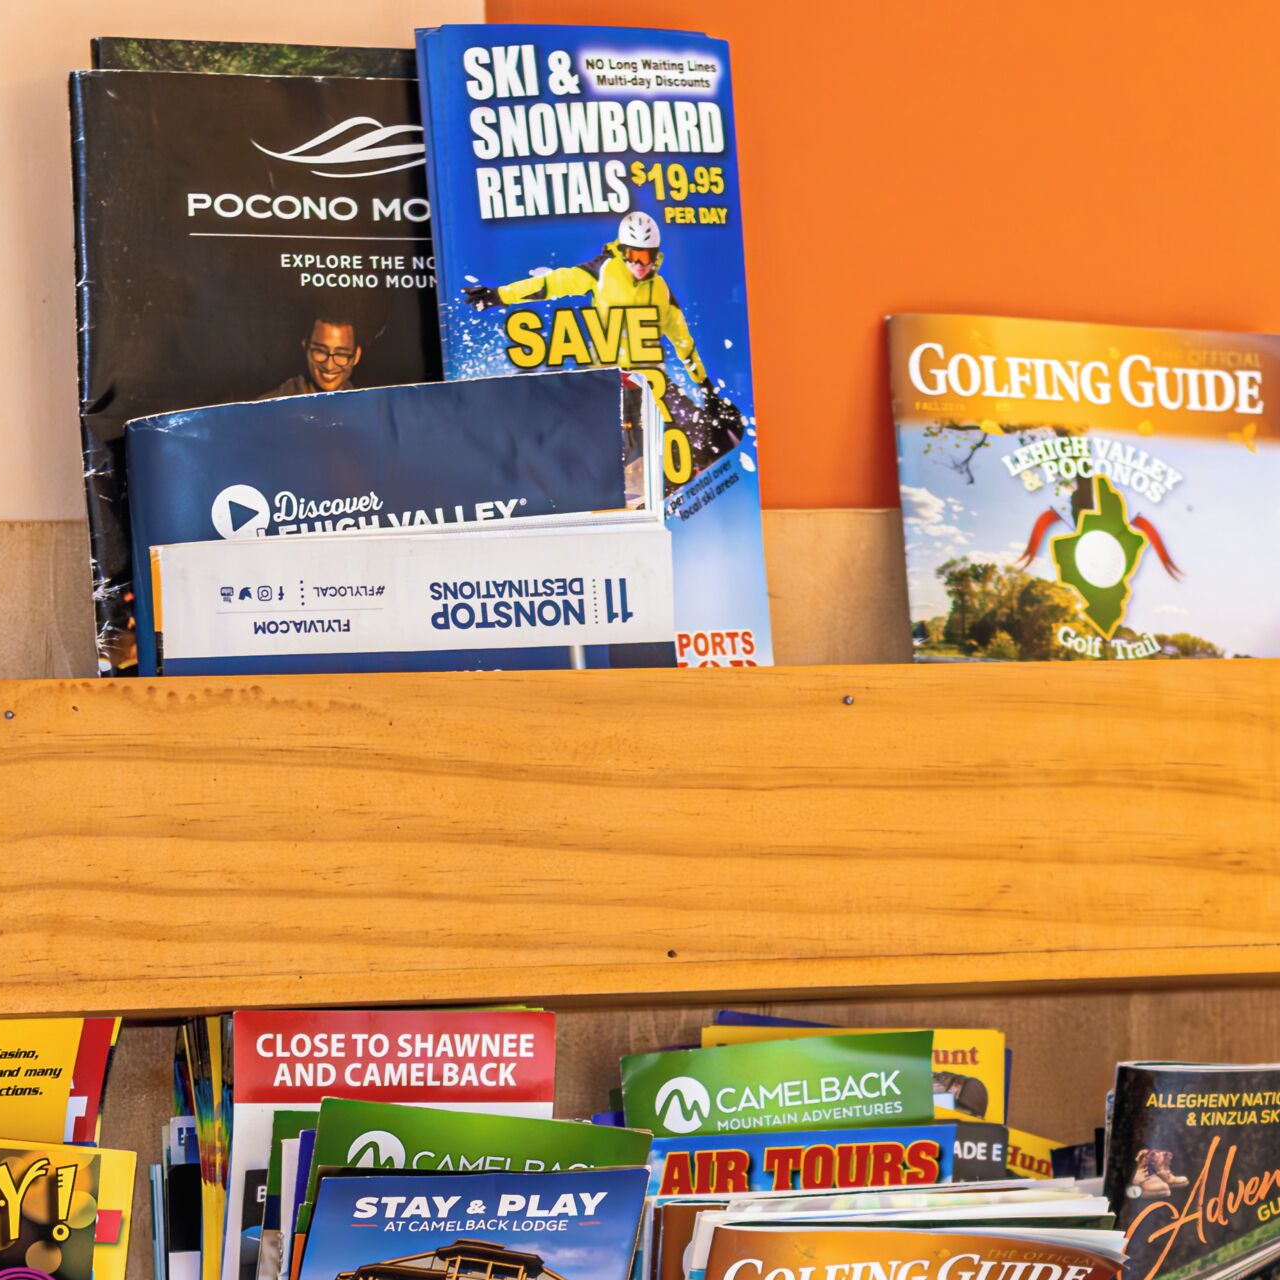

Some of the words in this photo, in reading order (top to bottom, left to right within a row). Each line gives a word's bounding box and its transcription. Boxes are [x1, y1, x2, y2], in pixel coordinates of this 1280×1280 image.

[464, 44, 538, 100] SKI
[548, 49, 579, 94] &
[585, 59, 604, 70] NO
[608, 59, 638, 72] Long
[641, 60, 684, 74] Waiting
[687, 61, 717, 73] Lines
[597, 75, 651, 88] Multi-day
[655, 75, 711, 88] Discounts
[471, 100, 725, 161] SNOWBOARD
[476, 160, 630, 220] RENTALS
[630, 161, 725, 201] $19.95
[188, 193, 358, 221] POCONO
[664, 207, 696, 225] PER
[698, 207, 727, 225] DAY
[280, 254, 364, 270] EXPLORE
[369, 254, 405, 270] THE
[301, 273, 379, 289] POCONO
[506, 305, 663, 368] SAVE
[907, 342, 1111, 405] GOLFING
[1118, 354, 1264, 415] GUIDE
[1001, 435, 1091, 477] LEHIGH
[1092, 437, 1183, 491] VALLEY
[1045, 456, 1167, 504] POCONOS
[273, 490, 384, 523] Discover
[312, 585, 386, 598] #FLYLOCAL
[429, 578, 585, 601] DESTINATIONS
[253, 619, 351, 635] FLYLVIA.COM
[430, 598, 587, 630] NONSTOP
[1057, 625, 1102, 660] Golf
[1110, 633, 1162, 660] Trail
[255, 1033, 345, 1058] CLOSE
[352, 1033, 389, 1058] TO
[396, 1033, 535, 1058] SHAWNEE
[27, 1066, 62, 1079] many
[273, 1063, 338, 1088] AND
[344, 1062, 517, 1088] CAMELBACK
[716, 1070, 902, 1114] CAMELBACK
[1146, 1093, 1240, 1108] ALLEGHENY
[717, 1113, 798, 1131] MOUNTAIN
[799, 1101, 904, 1123] ADVENTURES
[1186, 1112, 1197, 1126] &
[1200, 1111, 1258, 1125] KINZUA
[352, 1195, 462, 1219] STAY
[466, 1199, 487, 1215] &
[497, 1191, 609, 1217] PLAY
[384, 1221, 405, 1232] AT
[408, 1219, 509, 1232] CAMELBACK
[512, 1219, 569, 1232] LODGE
